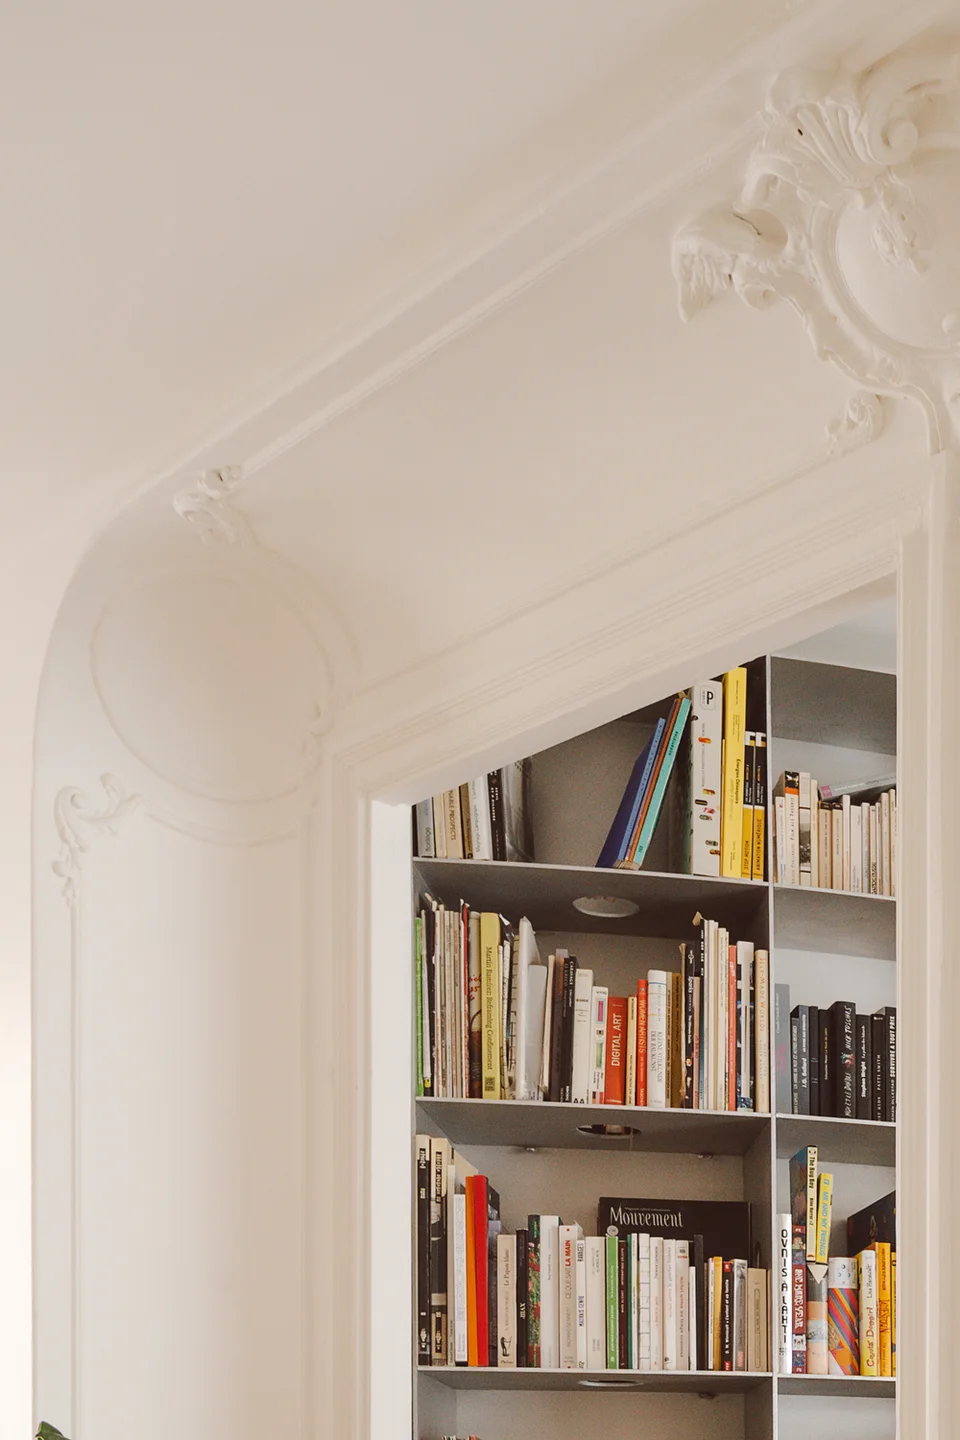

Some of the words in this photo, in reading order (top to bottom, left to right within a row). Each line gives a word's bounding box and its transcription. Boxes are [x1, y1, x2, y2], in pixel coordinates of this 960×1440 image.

[485, 997, 494, 1029] Reframing
[612, 1013, 622, 1030] ART
[638, 1000, 646, 1026] WOMEN
[844, 1005, 852, 1033] TOSCHES
[486, 1030, 494, 1071] Confinement
[611, 1035, 621, 1067] DIGITAL
[638, 1027, 646, 1054] ARTISTS
[844, 1035, 852, 1050] NICK
[808, 1167, 816, 1178] Bug
[808, 1178, 816, 1189] Boy
[823, 1191, 829, 1201] ME
[610, 1203, 684, 1228] Mouvement
[821, 1218, 828, 1228] MY
[780, 1229, 789, 1279] OVNIS
[820, 1230, 828, 1256] FRIENDS
[503, 1264, 511, 1280] Papou
[565, 1258, 571, 1267] LA
[794, 1269, 804, 1282] ONE
[794, 1284, 804, 1308] MORE
[780, 1296, 789, 1344] LAHTI
[794, 1310, 804, 1327] YEAR
[865, 1307, 875, 1338] Doggirl
[879, 1299, 890, 1334] JAMESTOWN
